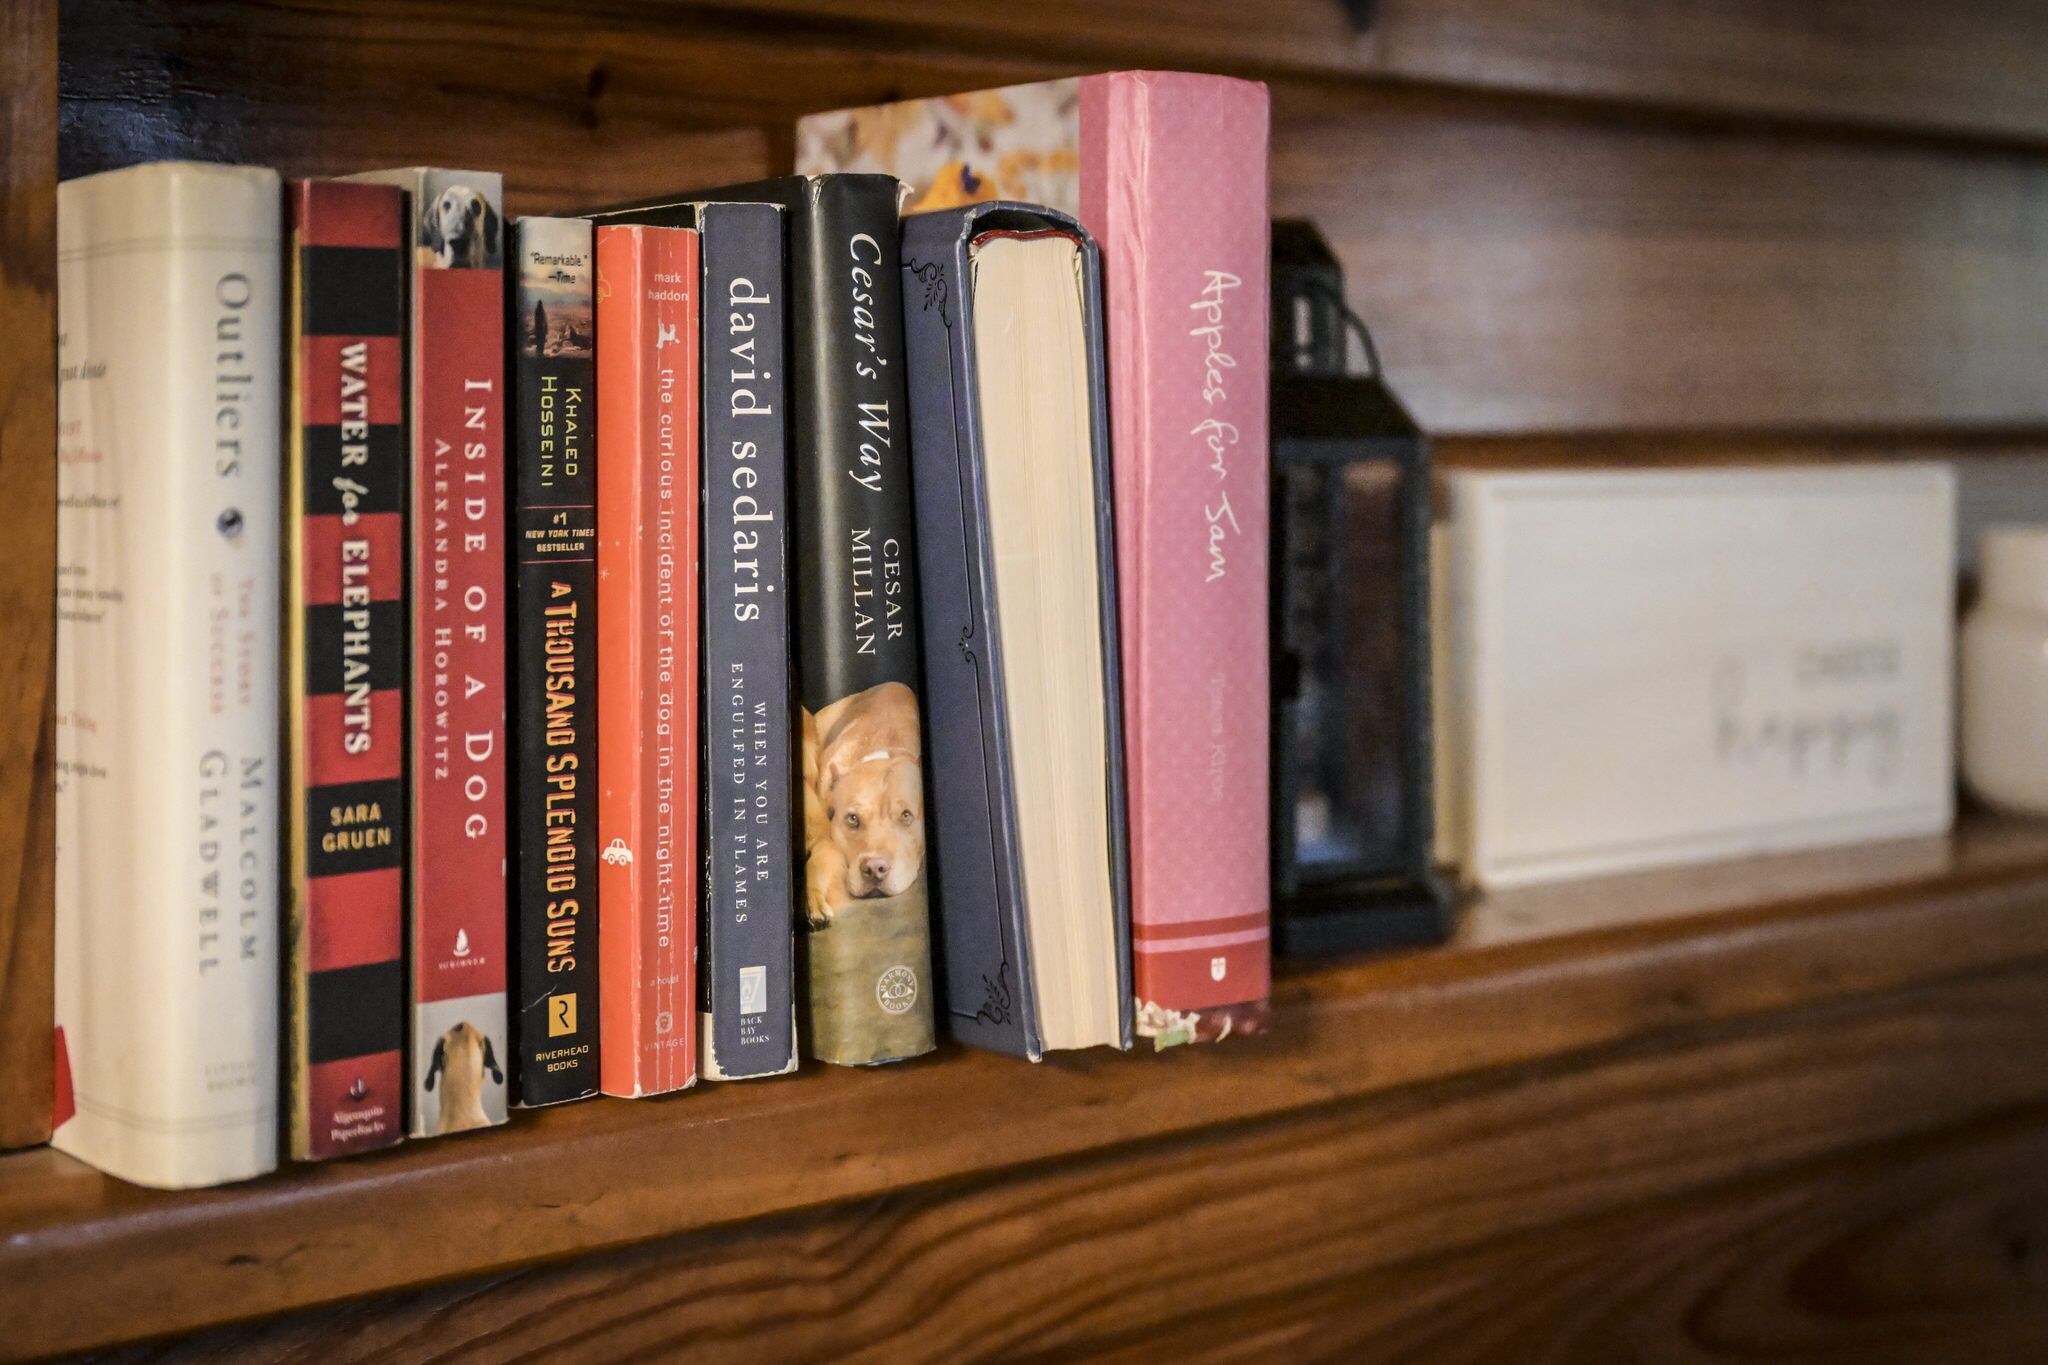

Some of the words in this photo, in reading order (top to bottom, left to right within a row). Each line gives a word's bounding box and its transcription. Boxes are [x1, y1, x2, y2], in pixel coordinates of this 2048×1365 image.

[648, 289, 688, 301] haddon
[654, 272, 681, 283] mark
[849, 232, 889, 380] Cesar's
[729, 277, 772, 418] david
[1189, 269, 1242, 405] Apples
[215, 272, 253, 478] Outliers
[339, 341, 369, 467] WATER
[660, 369, 675, 403] the
[541, 375, 558, 487] HOSSEINI
[564, 388, 582, 477] KHALED
[660, 414, 675, 499] curious
[848, 397, 892, 494] Way
[1190, 418, 1239, 481] for
[464, 378, 492, 553] INSIDE
[332, 476, 369, 526] for
[434, 438, 452, 611] ALEXANDRA
[525, 530, 545, 539] NEW
[548, 529, 569, 538] YORK
[572, 528, 595, 537] TIMES
[553, 511, 567, 525] #1
[731, 440, 774, 623] sedaris
[536, 542, 585, 553] BESTSELLER
[659, 511, 675, 603] incident
[1205, 491, 1241, 583] Jam
[464, 585, 487, 643] OF
[550, 581, 572, 599] A
[850, 527, 876, 656] MILLAN
[882, 538, 903, 642] CESAR
[341, 538, 372, 756] ELEPHANTS
[659, 614, 674, 638] of
[464, 676, 487, 698] A
[544, 600, 577, 748] THOUSAND
[659, 647, 674, 682] the
[434, 626, 452, 781] HOROWITZ
[657, 694, 674, 736] dog
[731, 663, 746, 784] ENGULFED
[754, 702, 767, 767] WHEN
[464, 731, 493, 839] DOG
[658, 746, 674, 767] in
[329, 802, 382, 827] SARA
[545, 752, 580, 893] SPLENDID
[658, 774, 674, 815] the
[733, 798, 746, 820] IN
[755, 779, 768, 825] YOU
[199, 748, 228, 977] GLADWELL
[239, 755, 266, 962] MALCOLM
[321, 827, 391, 853] GRUEN
[756, 838, 768, 882] ARE
[656, 825, 674, 948] night-time
[734, 835, 747, 923] FLAMES
[546, 898, 580, 974] SUNS
[535, 1044, 589, 1061] RIVERHEAD
[644, 1038, 685, 1052] VINTAGE
[740, 1016, 762, 1026] BACK
[740, 1026, 756, 1036] BAY
[740, 1035, 770, 1046] BOOKS
[547, 1059, 578, 1073] BOOKS
